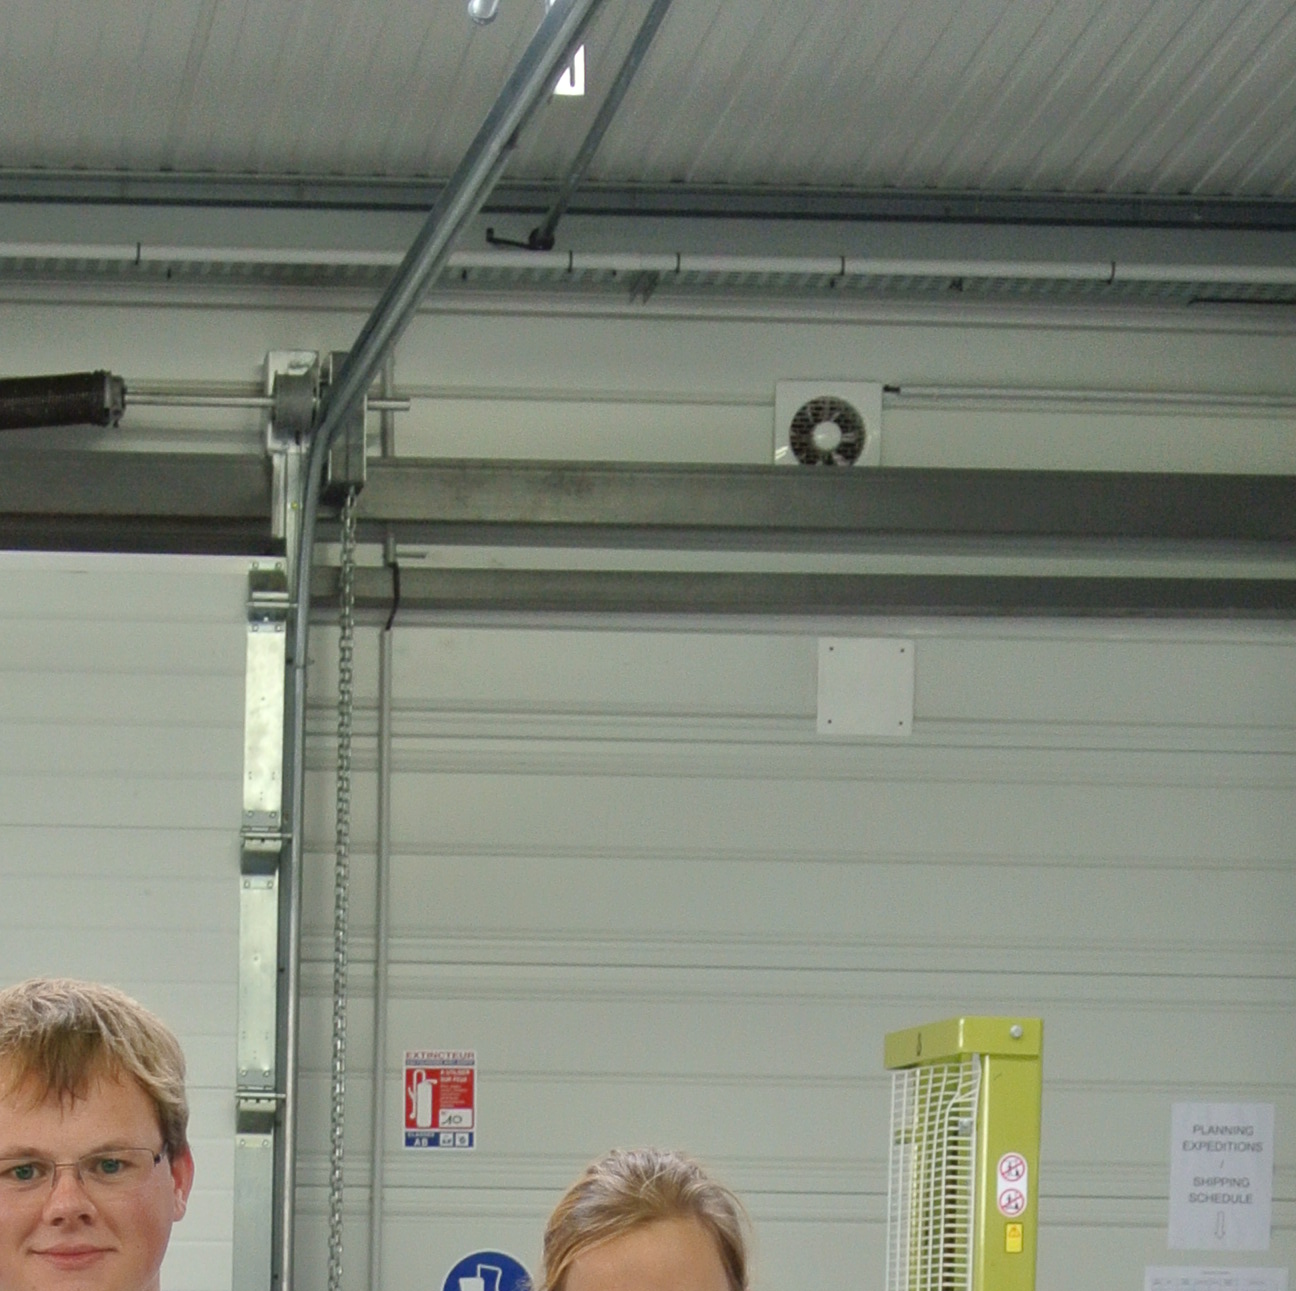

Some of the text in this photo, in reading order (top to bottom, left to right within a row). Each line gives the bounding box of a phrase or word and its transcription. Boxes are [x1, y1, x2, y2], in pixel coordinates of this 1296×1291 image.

[1193, 1125, 1254, 1136] PLANNING
[1182, 1140, 1264, 1153] EXPEDITIONS
[1193, 1176, 1251, 1188] SHIPPING
[1188, 1192, 1253, 1204] SCHEDULE
